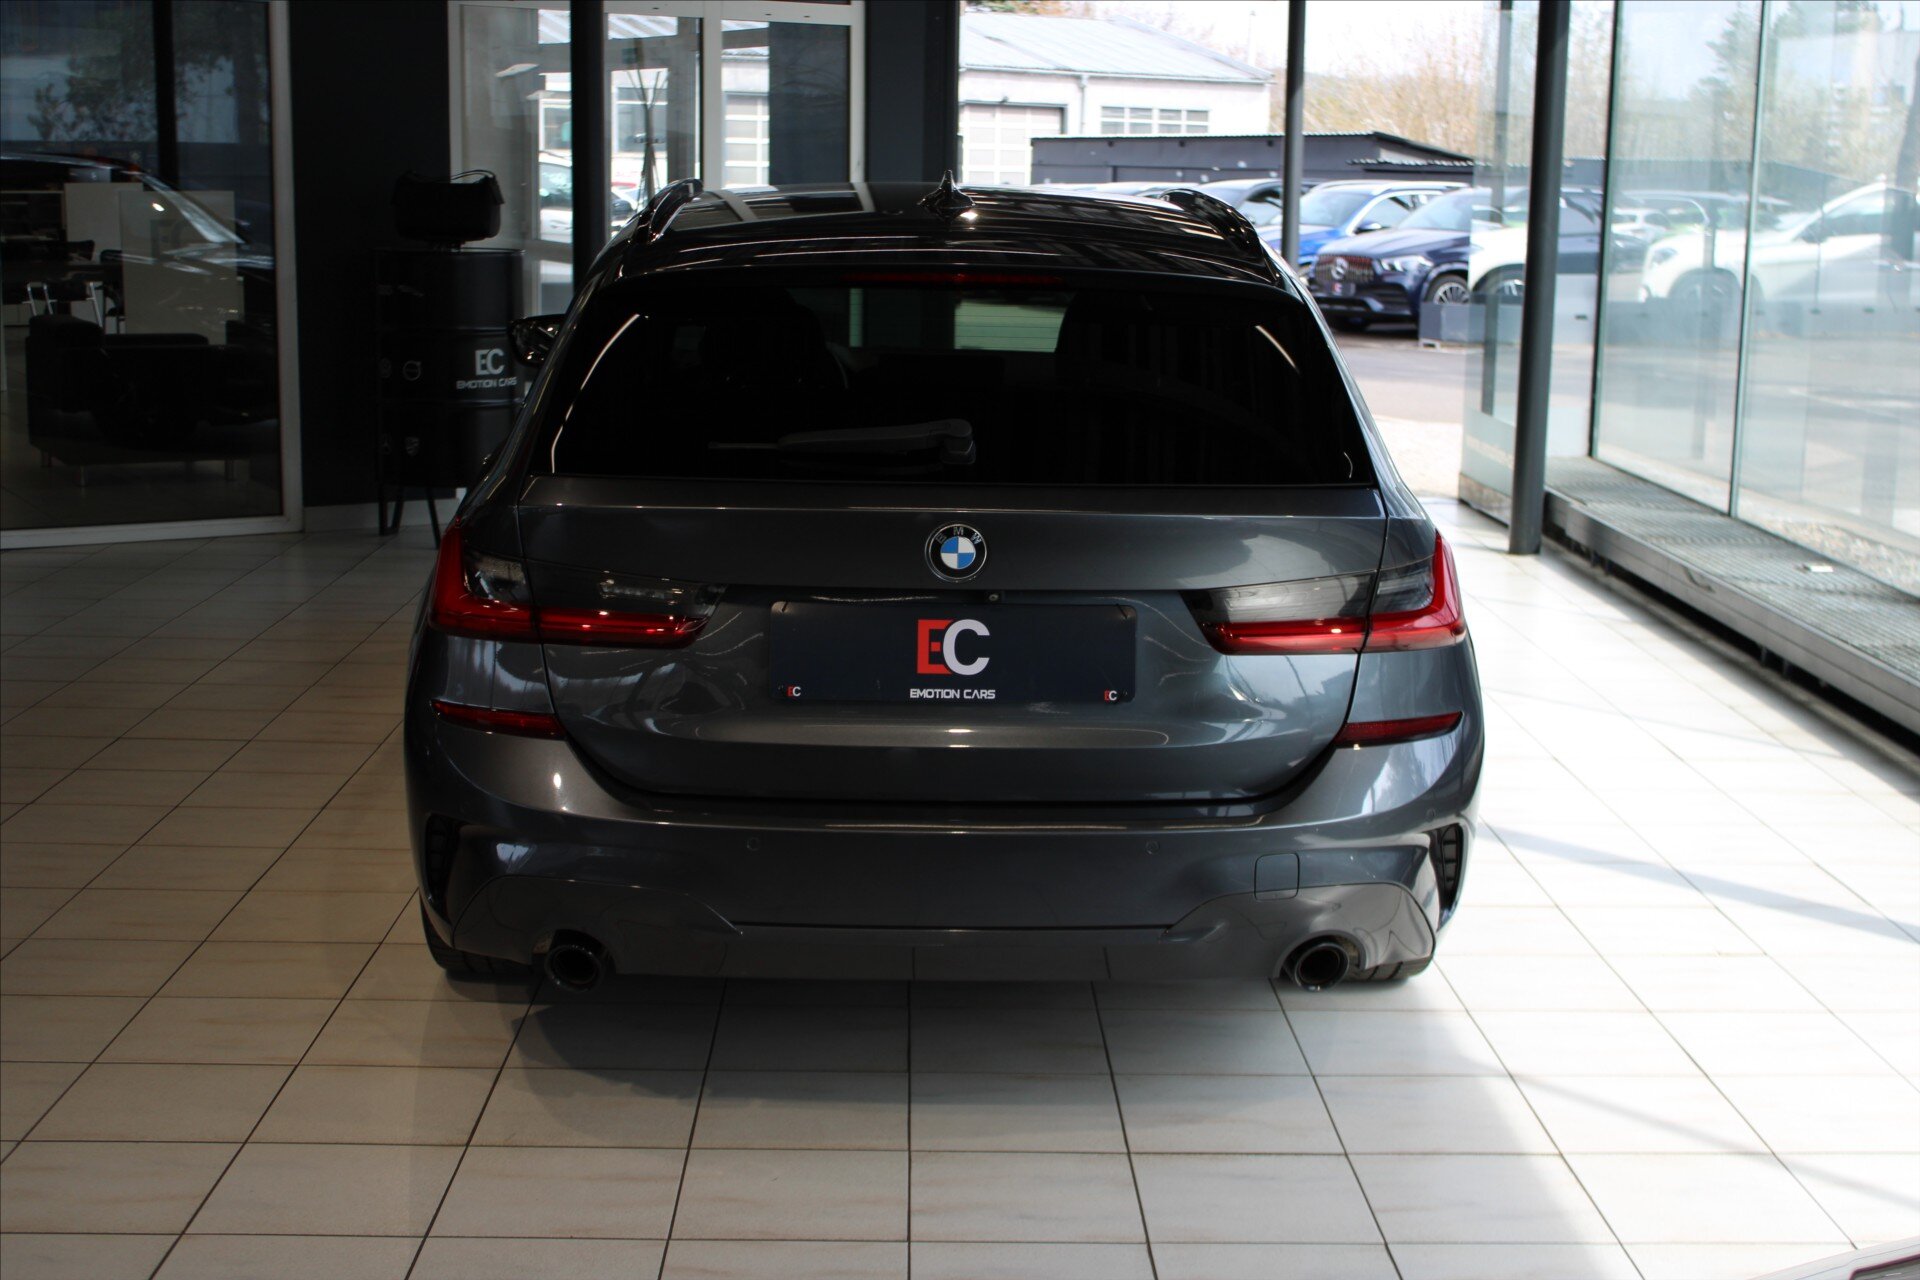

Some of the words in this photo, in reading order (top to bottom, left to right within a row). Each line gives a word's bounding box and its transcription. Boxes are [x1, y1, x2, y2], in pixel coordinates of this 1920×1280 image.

[475, 348, 504, 375] EC
[457, 379, 497, 389] EMOTION
[935, 526, 983, 544] BMW
[917, 619, 990, 675] EC
[909, 688, 960, 699] EMOTION
[963, 689, 996, 699] CARS
